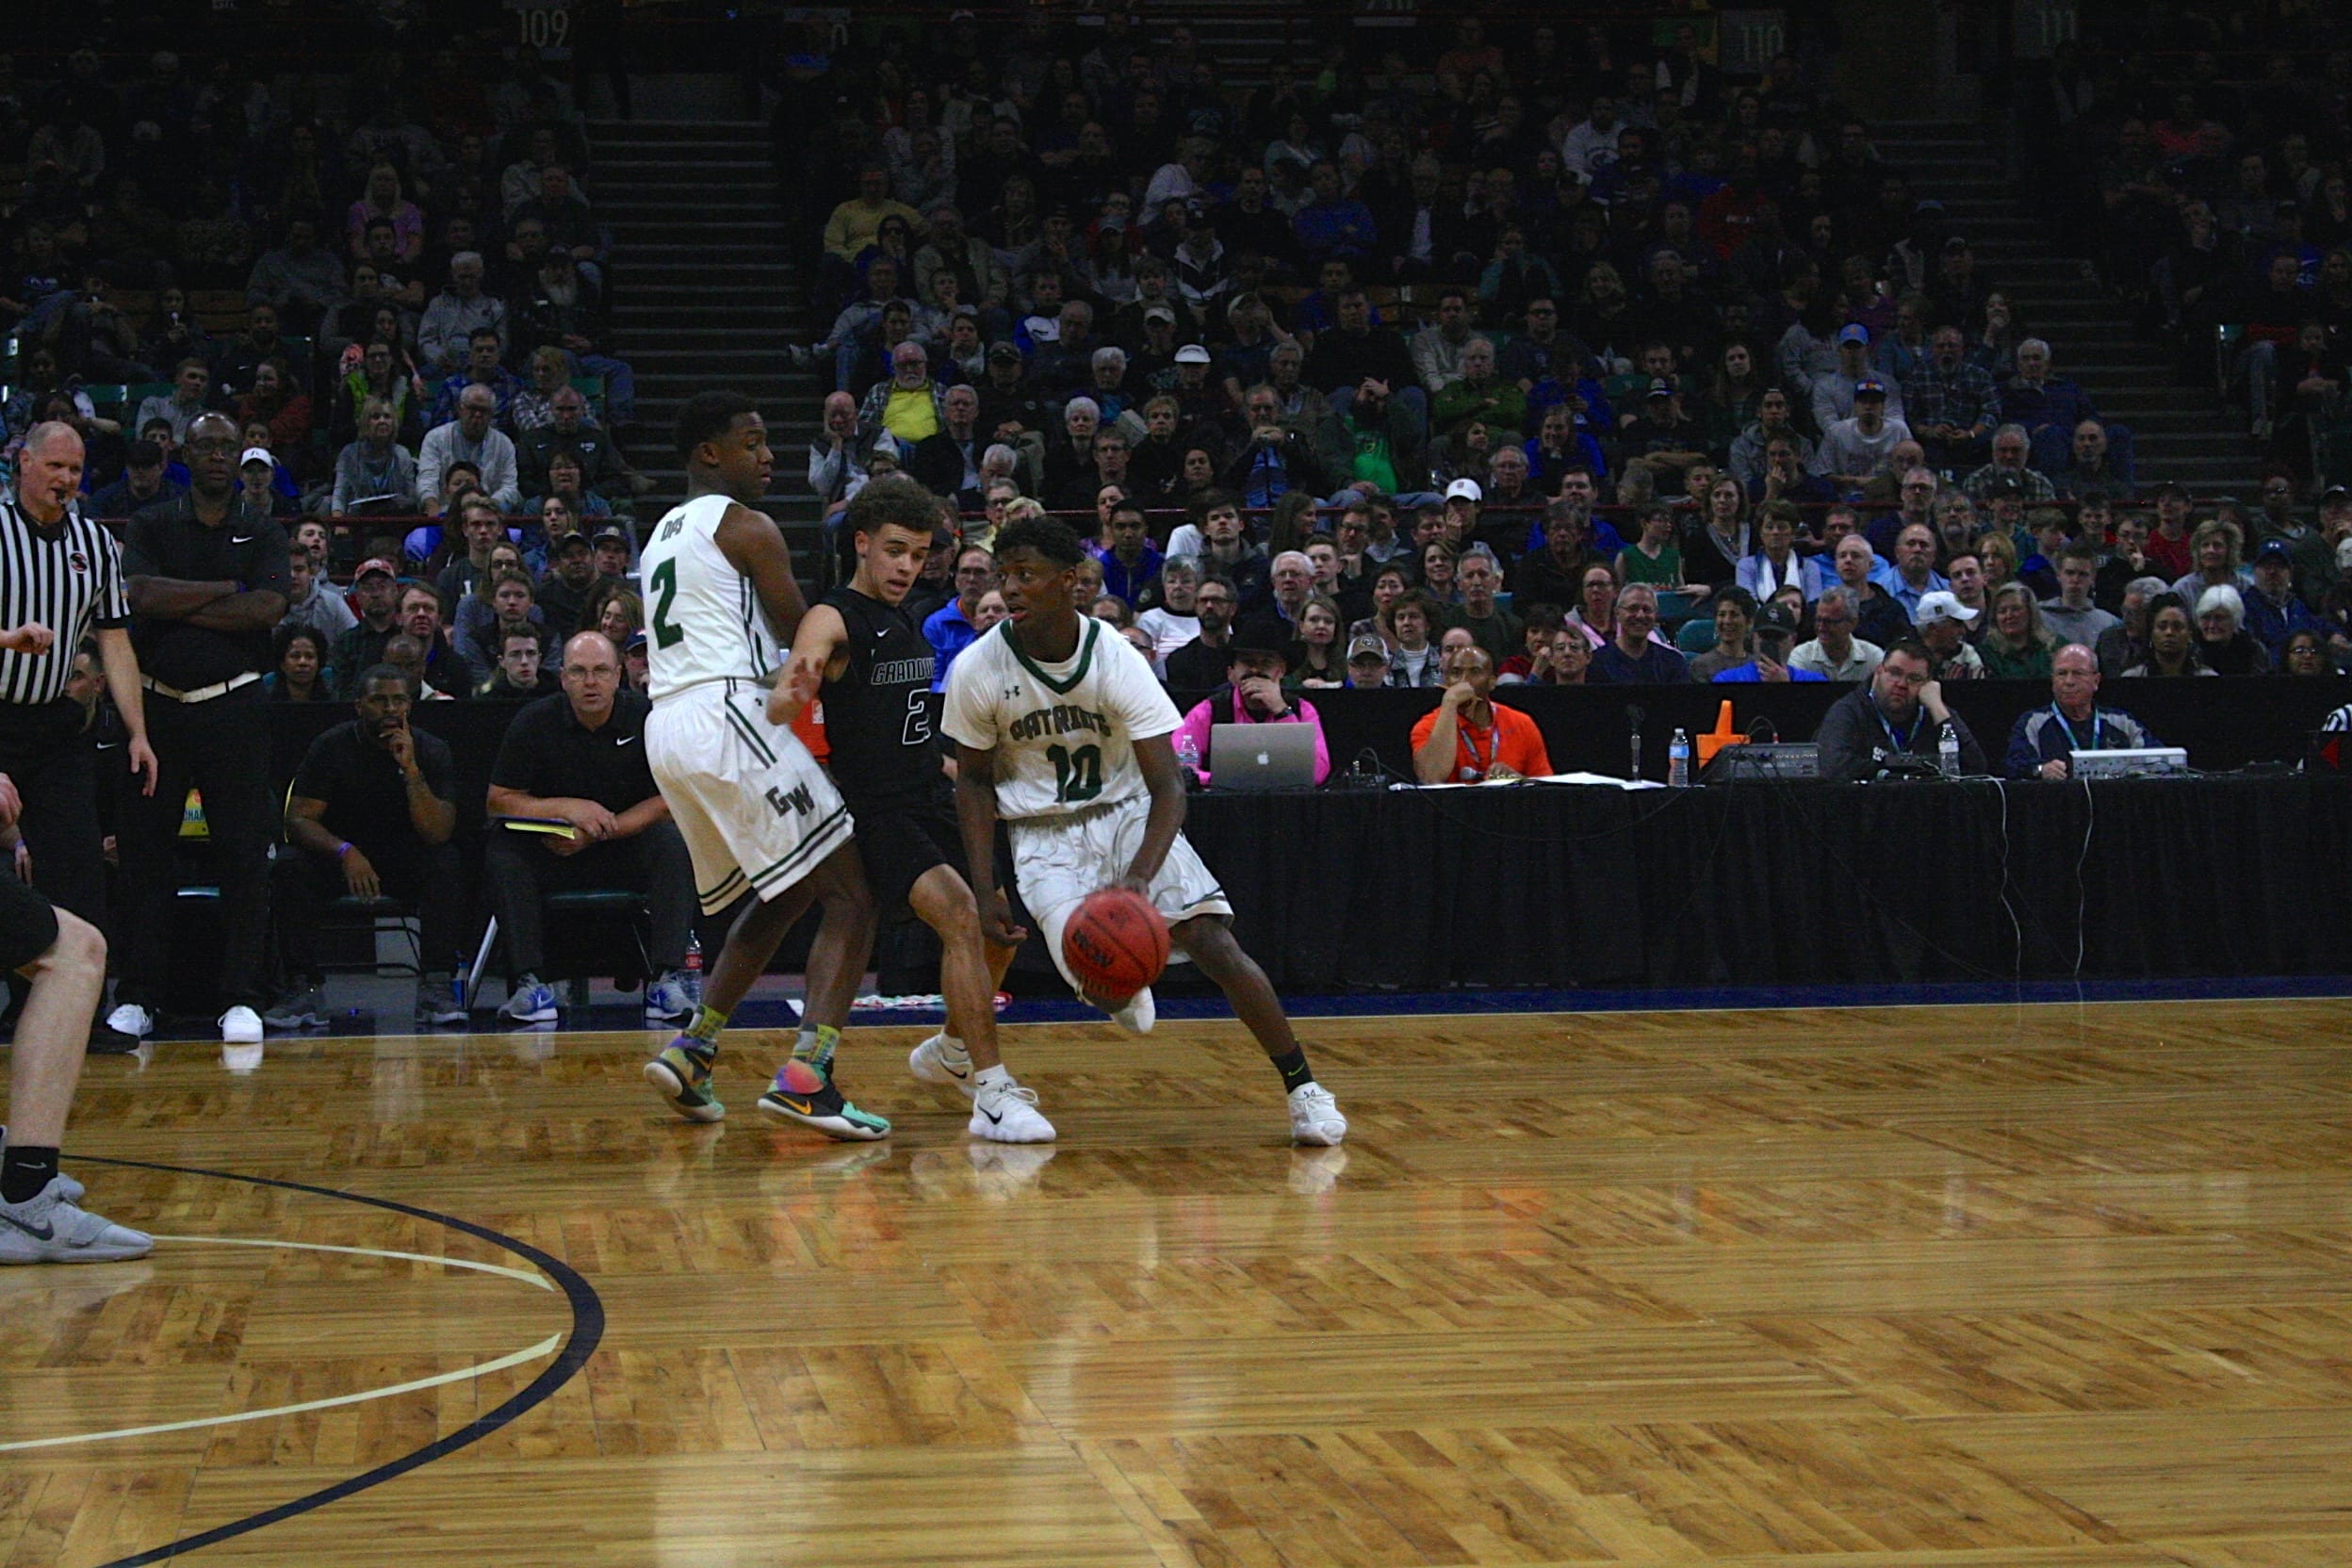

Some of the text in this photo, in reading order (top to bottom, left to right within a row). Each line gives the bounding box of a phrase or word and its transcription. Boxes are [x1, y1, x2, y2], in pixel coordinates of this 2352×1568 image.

[515, 8, 569, 47] 109
[650, 556, 685, 650] 2
[901, 687, 932, 746] 2
[764, 780, 815, 819] GW
[1045, 743, 1102, 803] 10
